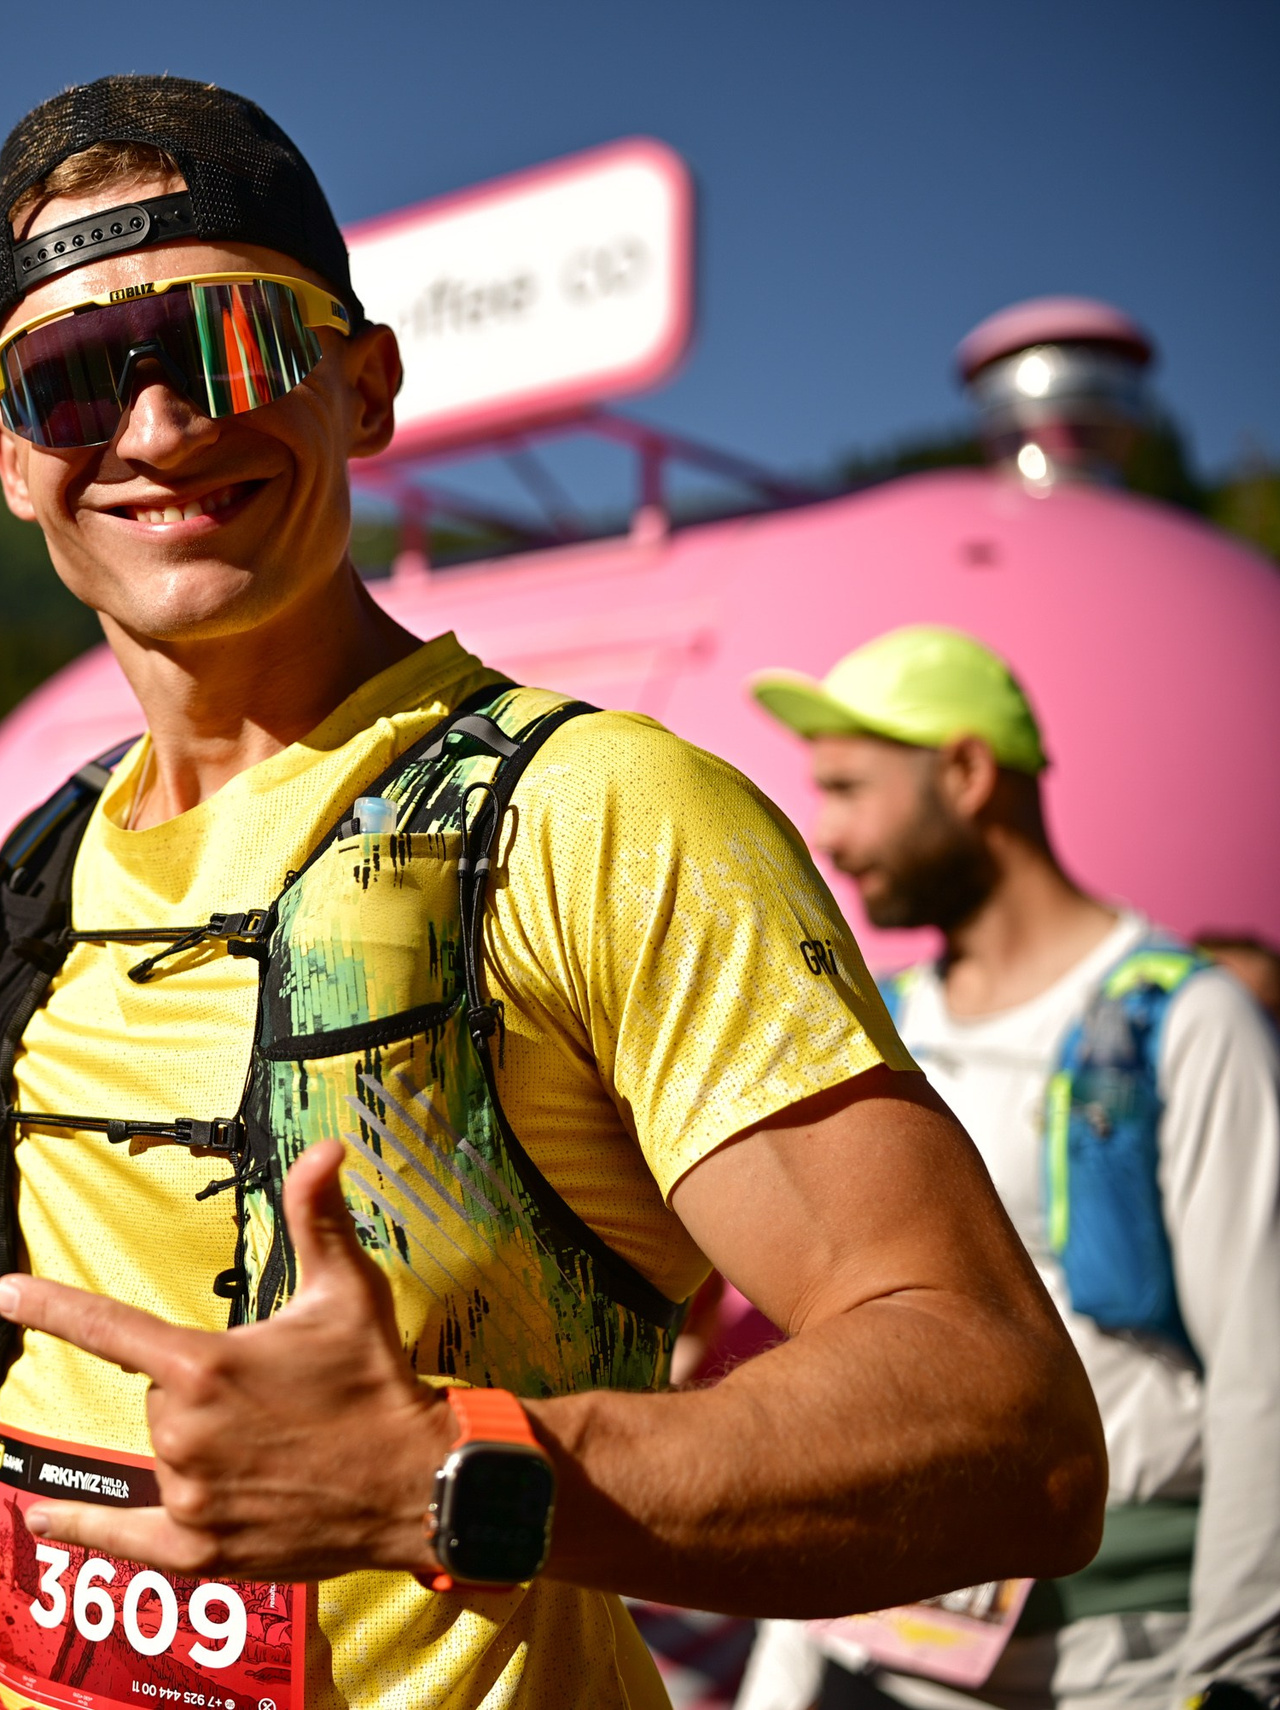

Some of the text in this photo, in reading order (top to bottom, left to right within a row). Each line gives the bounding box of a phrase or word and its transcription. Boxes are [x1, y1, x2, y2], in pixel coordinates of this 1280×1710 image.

[125, 282, 155, 298] BLIZ
[39, 1463, 122, 1493] ARKHYZ WILD
[101, 1485, 124, 1497] TRAIL
[29, 1543, 247, 1668] 3609
[132, 1680, 140, 1693] 11
[142, 1682, 156, 1696] 00
[159, 1686, 181, 1701] 444
[184, 1691, 205, 1705] 925
[207, 1696, 222, 1707] +7
